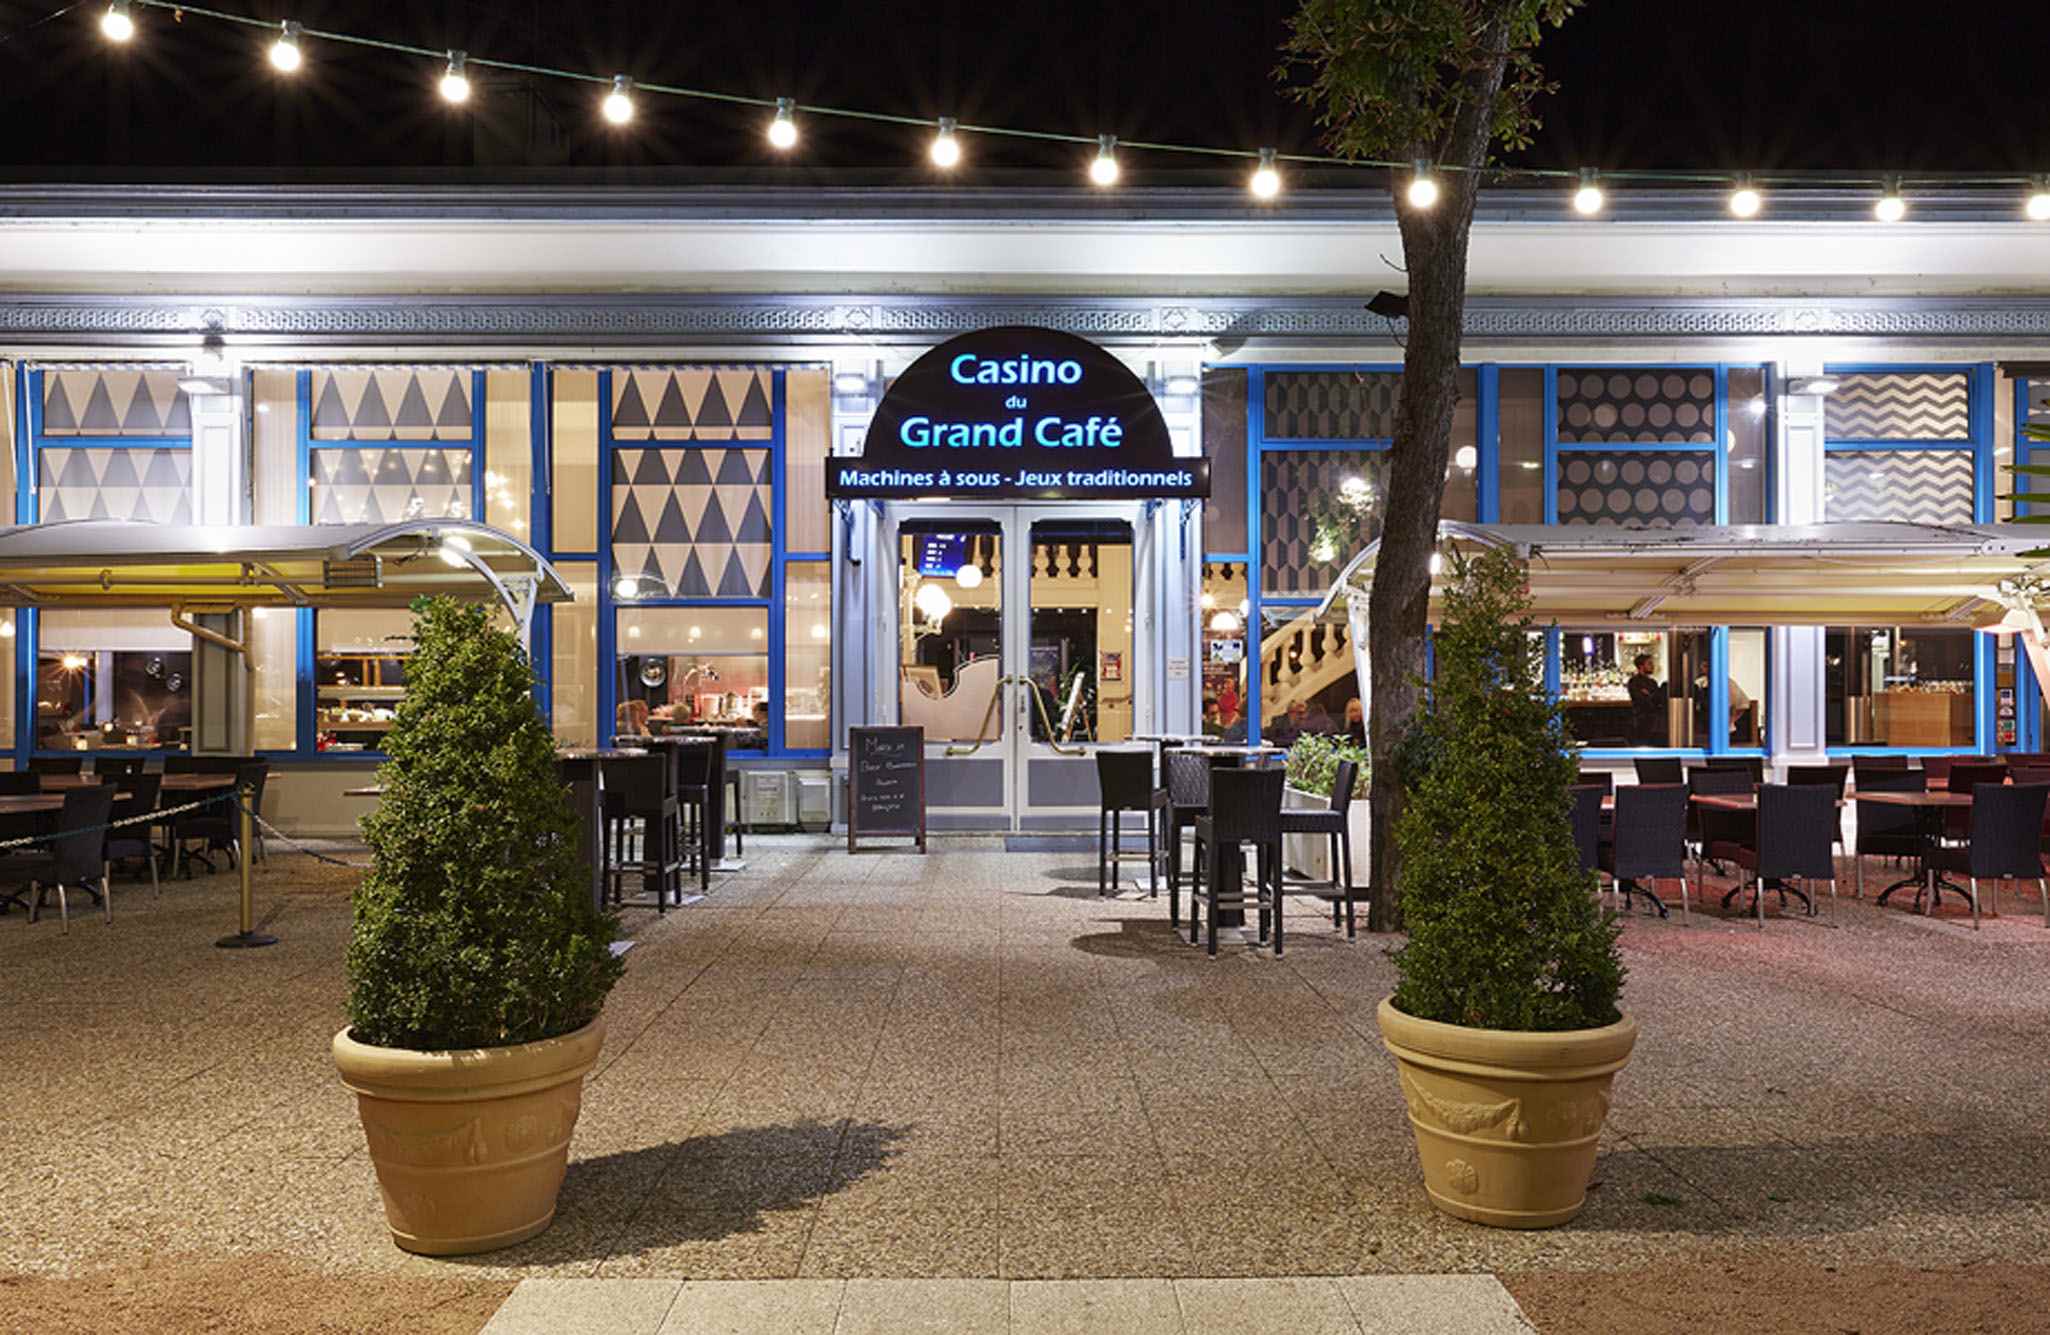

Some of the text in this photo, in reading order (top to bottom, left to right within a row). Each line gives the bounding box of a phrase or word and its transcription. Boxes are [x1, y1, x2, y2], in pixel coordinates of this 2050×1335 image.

[950, 354, 1083, 385] Casino
[1005, 394, 1028, 410] du
[900, 416, 1123, 448] Grand Café
[839, 469, 935, 487] Machines
[937, 469, 952, 487] à
[955, 472, 1001, 487] sous
[1014, 469, 1063, 487] Jeux
[1066, 469, 1193, 487] traditionnels
